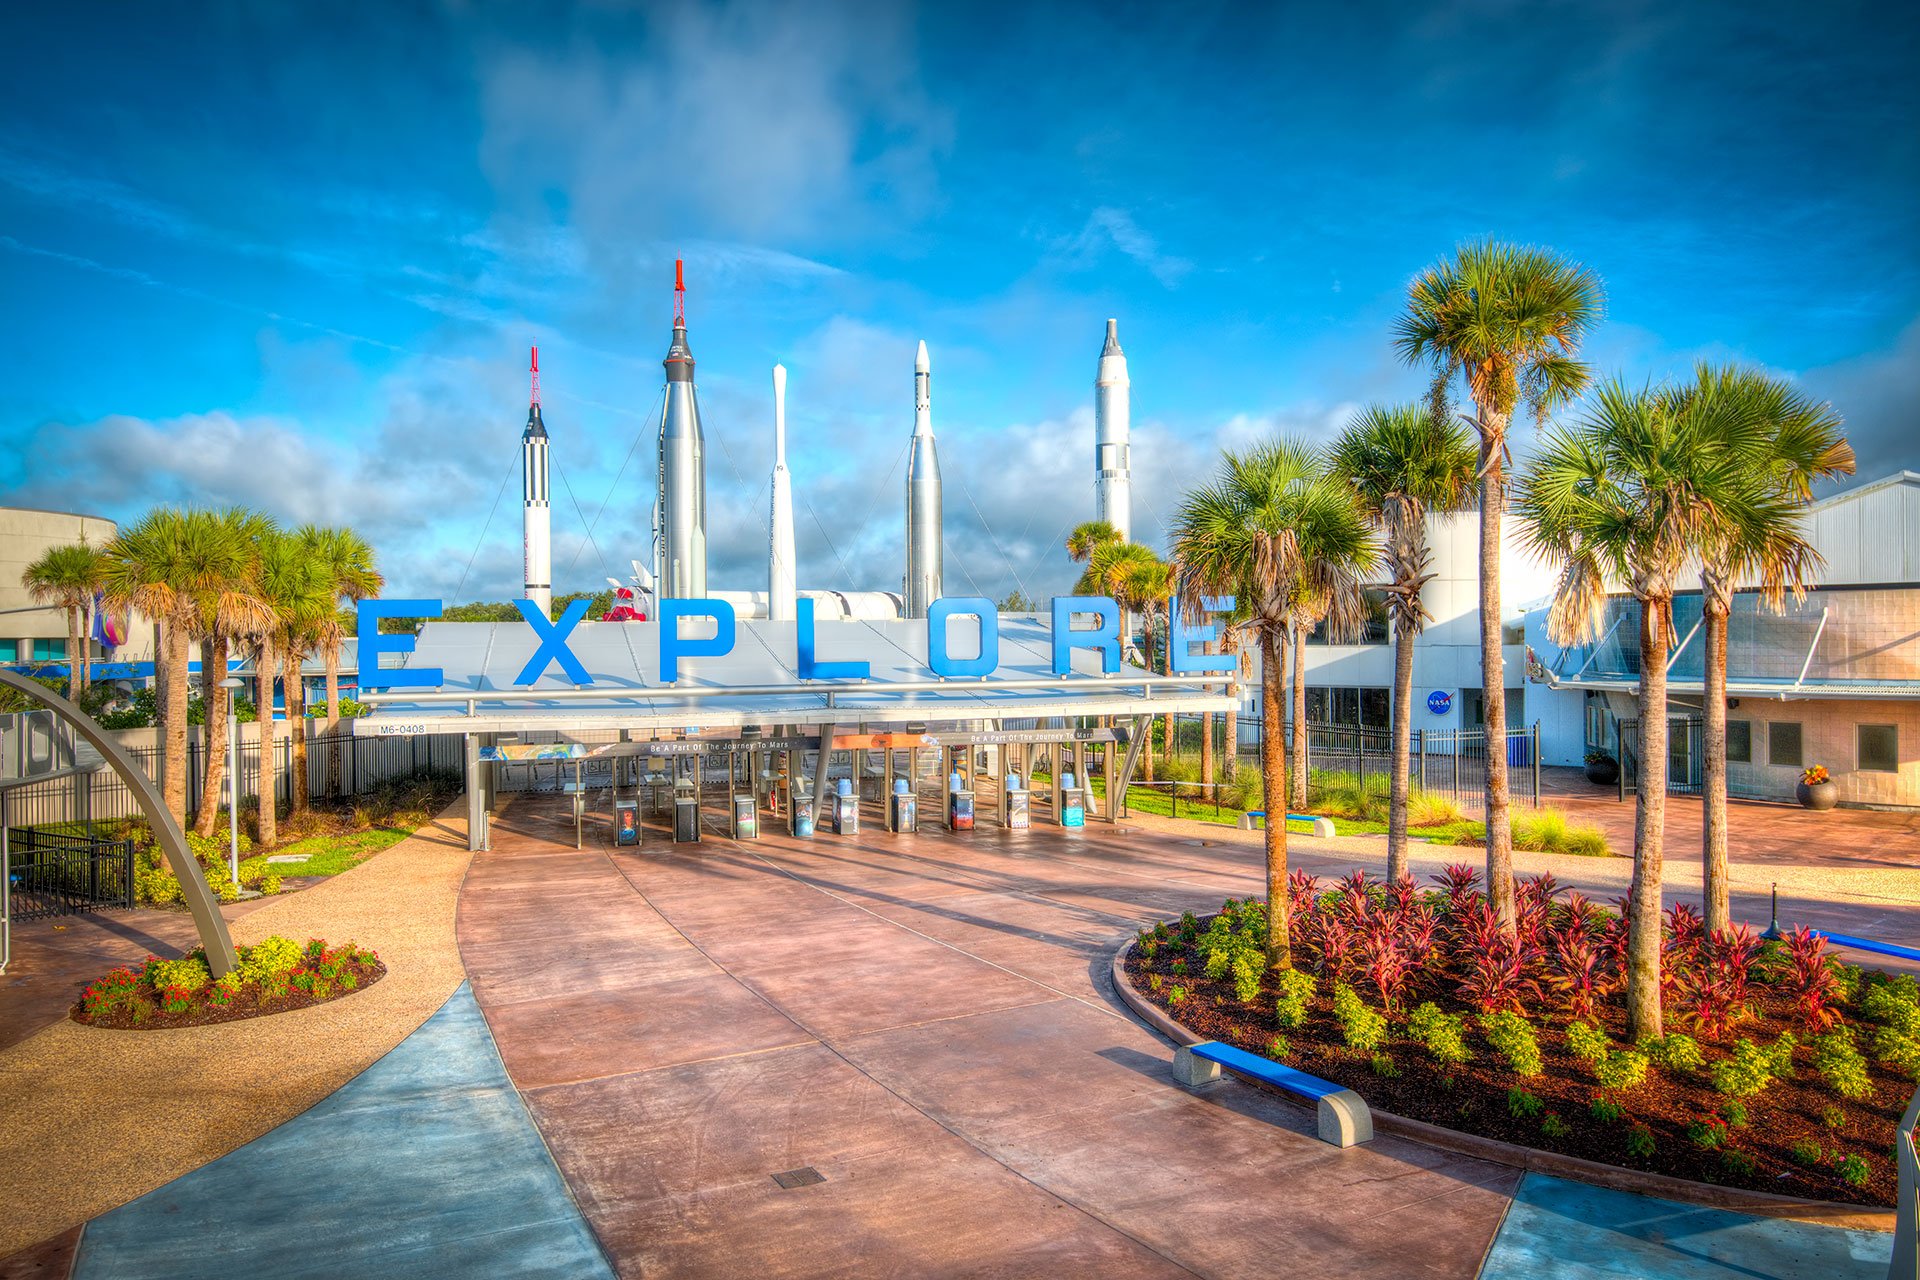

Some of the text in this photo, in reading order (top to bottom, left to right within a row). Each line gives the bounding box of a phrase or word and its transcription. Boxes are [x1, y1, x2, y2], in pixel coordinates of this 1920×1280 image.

[358, 595, 1237, 688] EXPLORE
[380, 724, 425, 734] M6-0408
[990, 734, 1006, 742] Part
[1020, 733, 1033, 741] The
[1035, 732, 1064, 741] Journey
[1066, 732, 1074, 740] To
[650, 744, 661, 752] Be
[664, 744, 669, 752] A
[672, 744, 690, 752] Part
[693, 743, 702, 751] Of
[722, 742, 754, 751] Journey
[757, 741, 767, 749] To
[769, 741, 789, 749] Mars
